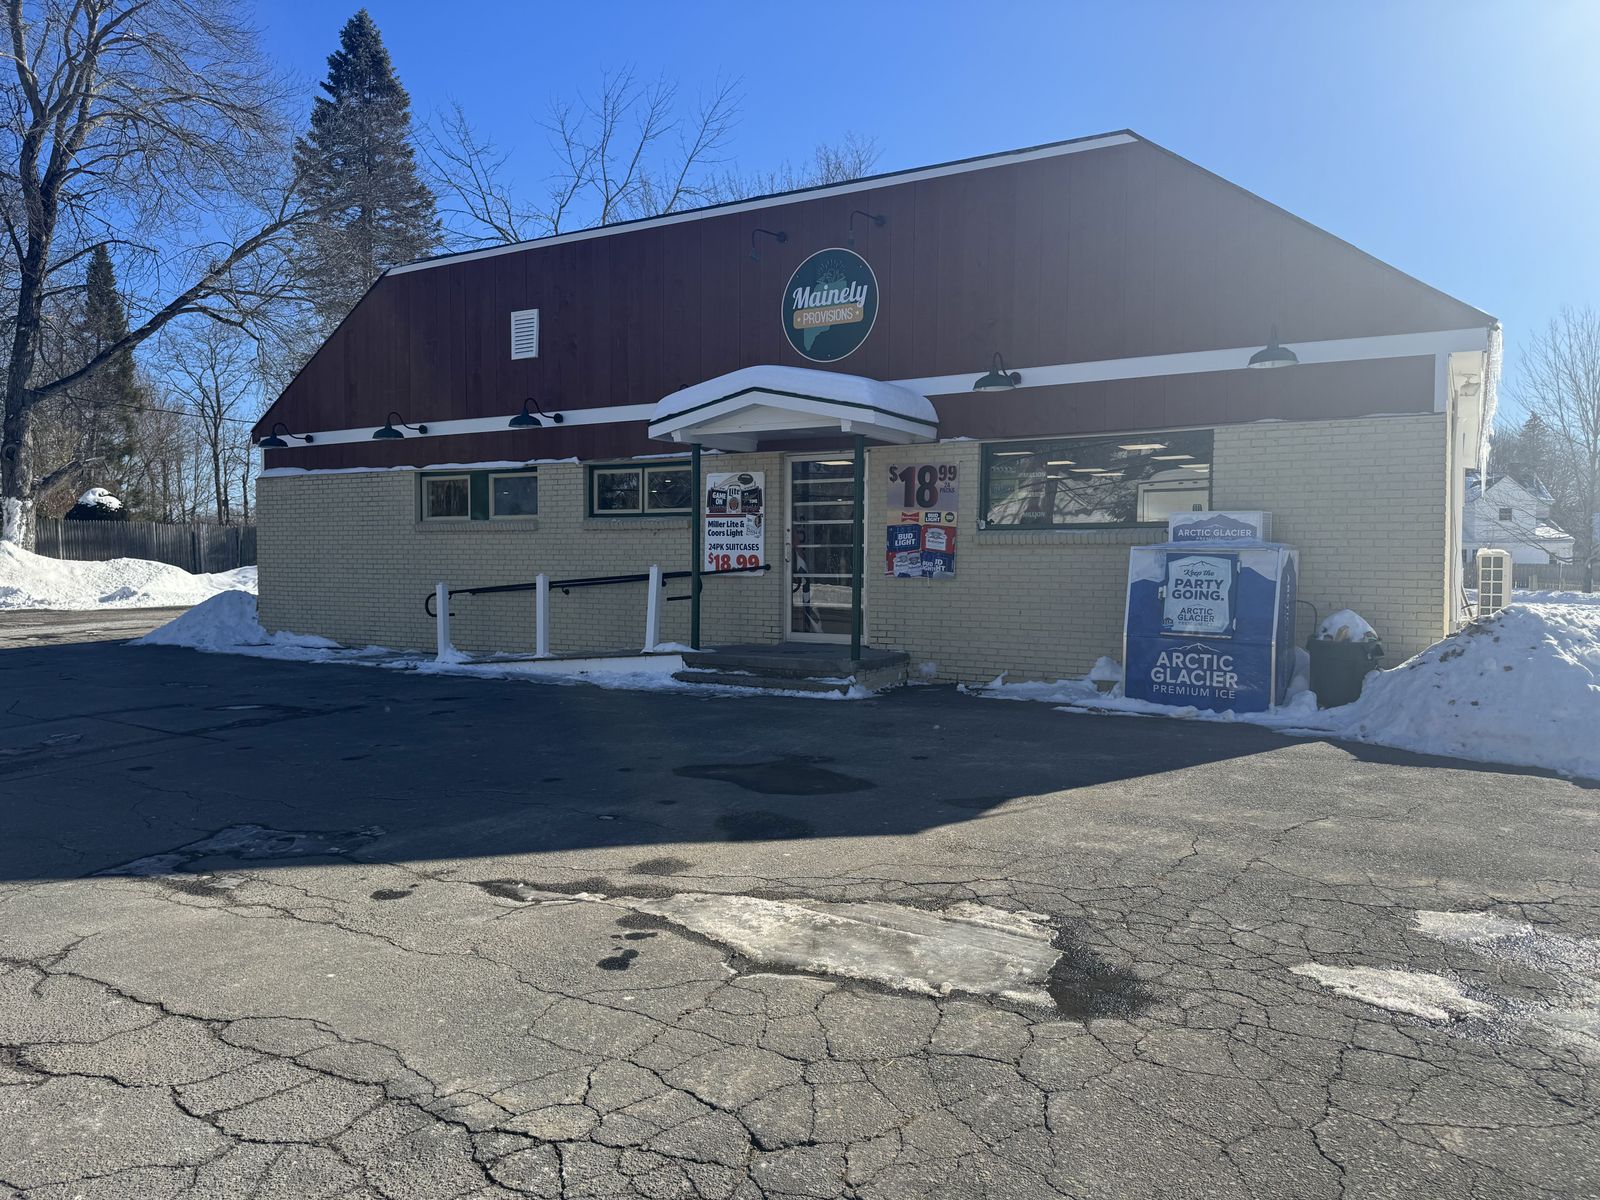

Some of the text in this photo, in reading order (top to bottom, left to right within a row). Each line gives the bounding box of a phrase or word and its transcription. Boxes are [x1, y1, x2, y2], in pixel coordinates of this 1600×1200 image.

[793, 281, 868, 308] Mainely
[803, 307, 853, 324] PROVISIONS
[712, 491, 727, 500] GAME
[707, 520, 745, 528] Miller Lite &
[707, 529, 743, 538] Coors Light
[1178, 529, 1252, 537] ARCTIC GLACIER
[708, 543, 760, 551] 24PK SUITCASES
[895, 539, 916, 547] LIGHT
[1183, 569, 1202, 577] Keep
[1174, 578, 1224, 590] PARTY
[1171, 589, 1225, 601] GOING.
[1180, 607, 1214, 615] ARCTIC
[1177, 614, 1215, 622] GLACIER
[1156, 651, 1234, 671] ARCTIC
[1151, 667, 1238, 688] GLACIER
[1153, 684, 1235, 699] PREMIUM ICE
